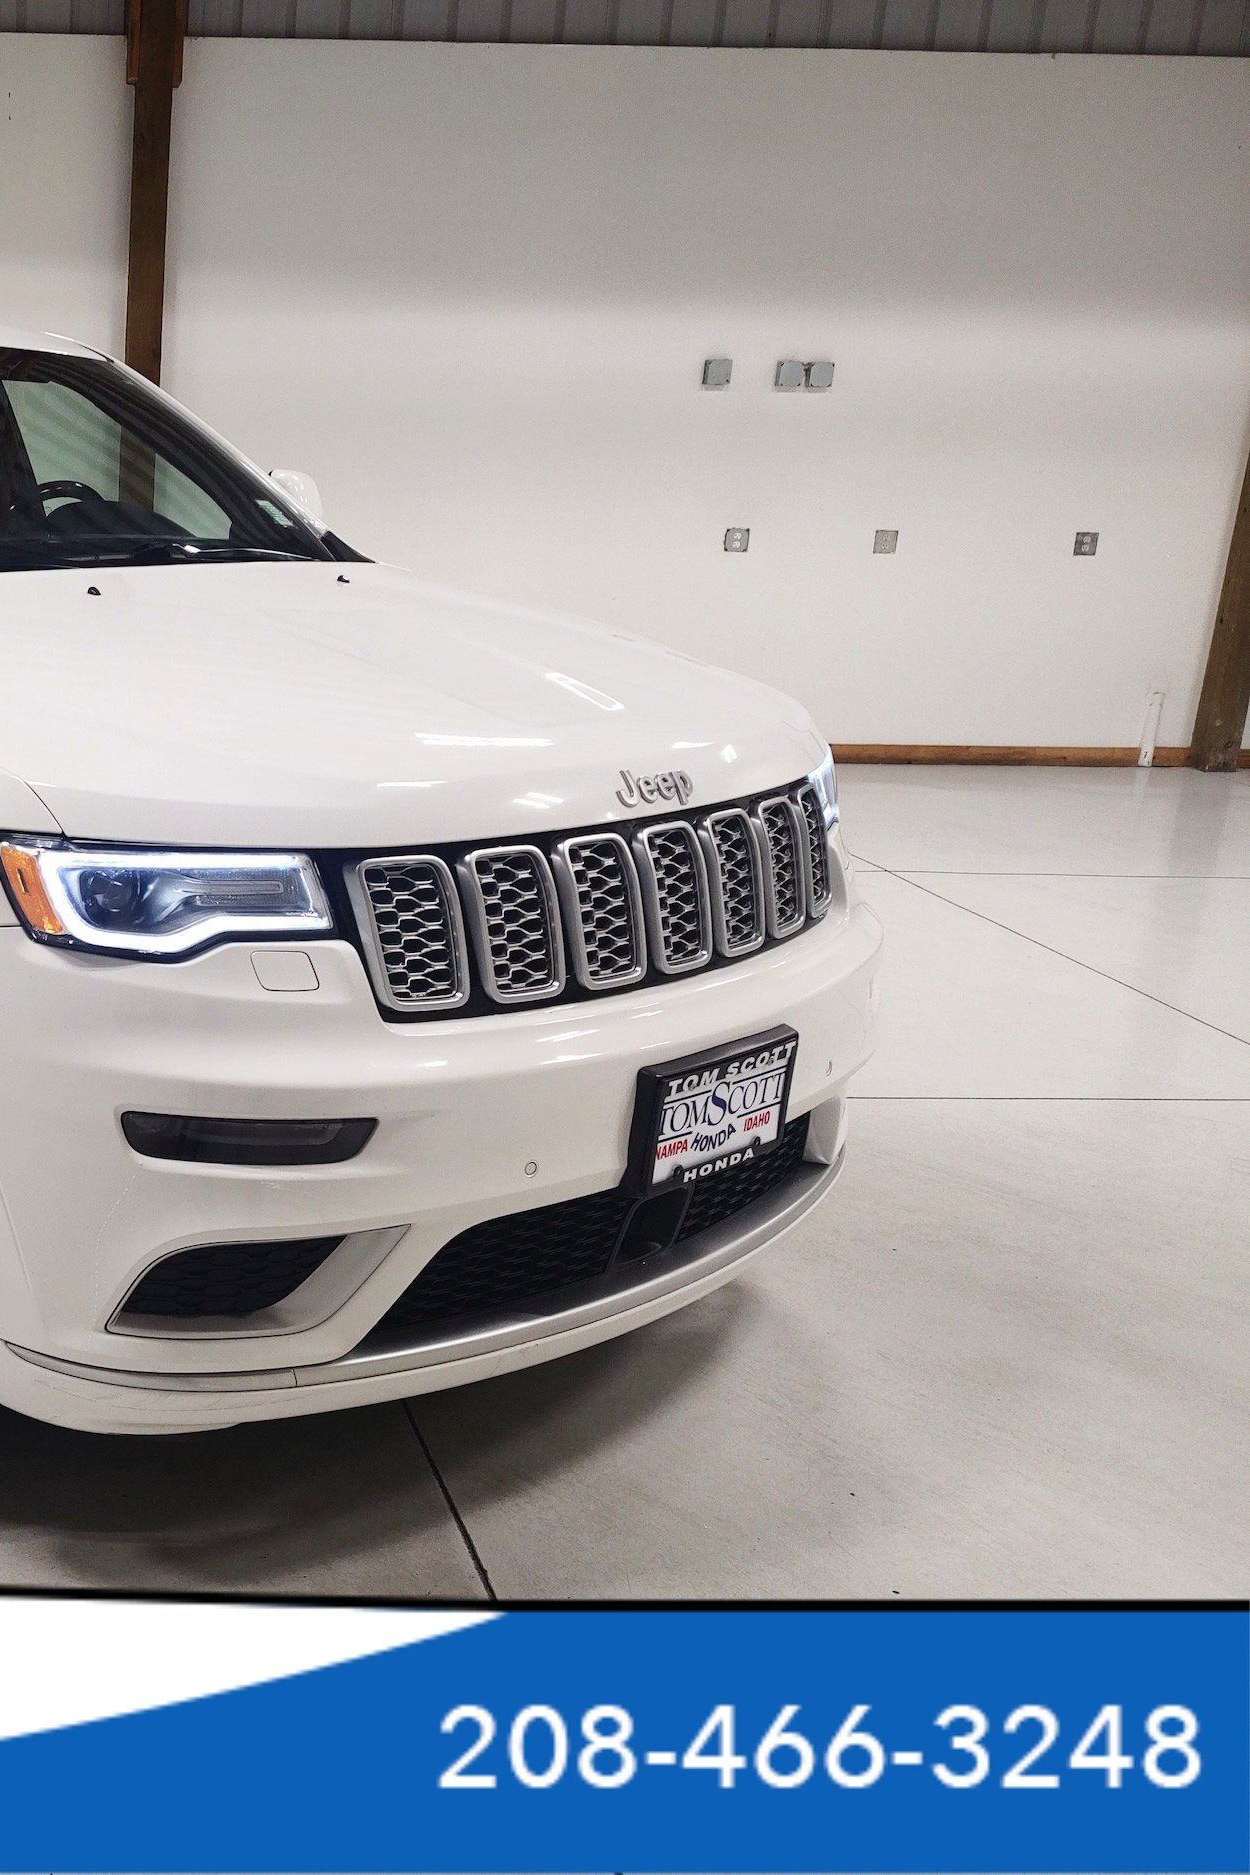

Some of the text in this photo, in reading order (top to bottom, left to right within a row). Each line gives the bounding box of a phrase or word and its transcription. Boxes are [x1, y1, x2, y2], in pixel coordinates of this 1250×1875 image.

[616, 769, 694, 808] Jeep
[666, 1040, 796, 1098] TOM SCOTT
[691, 1123, 736, 1151] HONDA
[743, 1111, 771, 1132] IDAHO
[683, 1148, 754, 1182] HONDA
